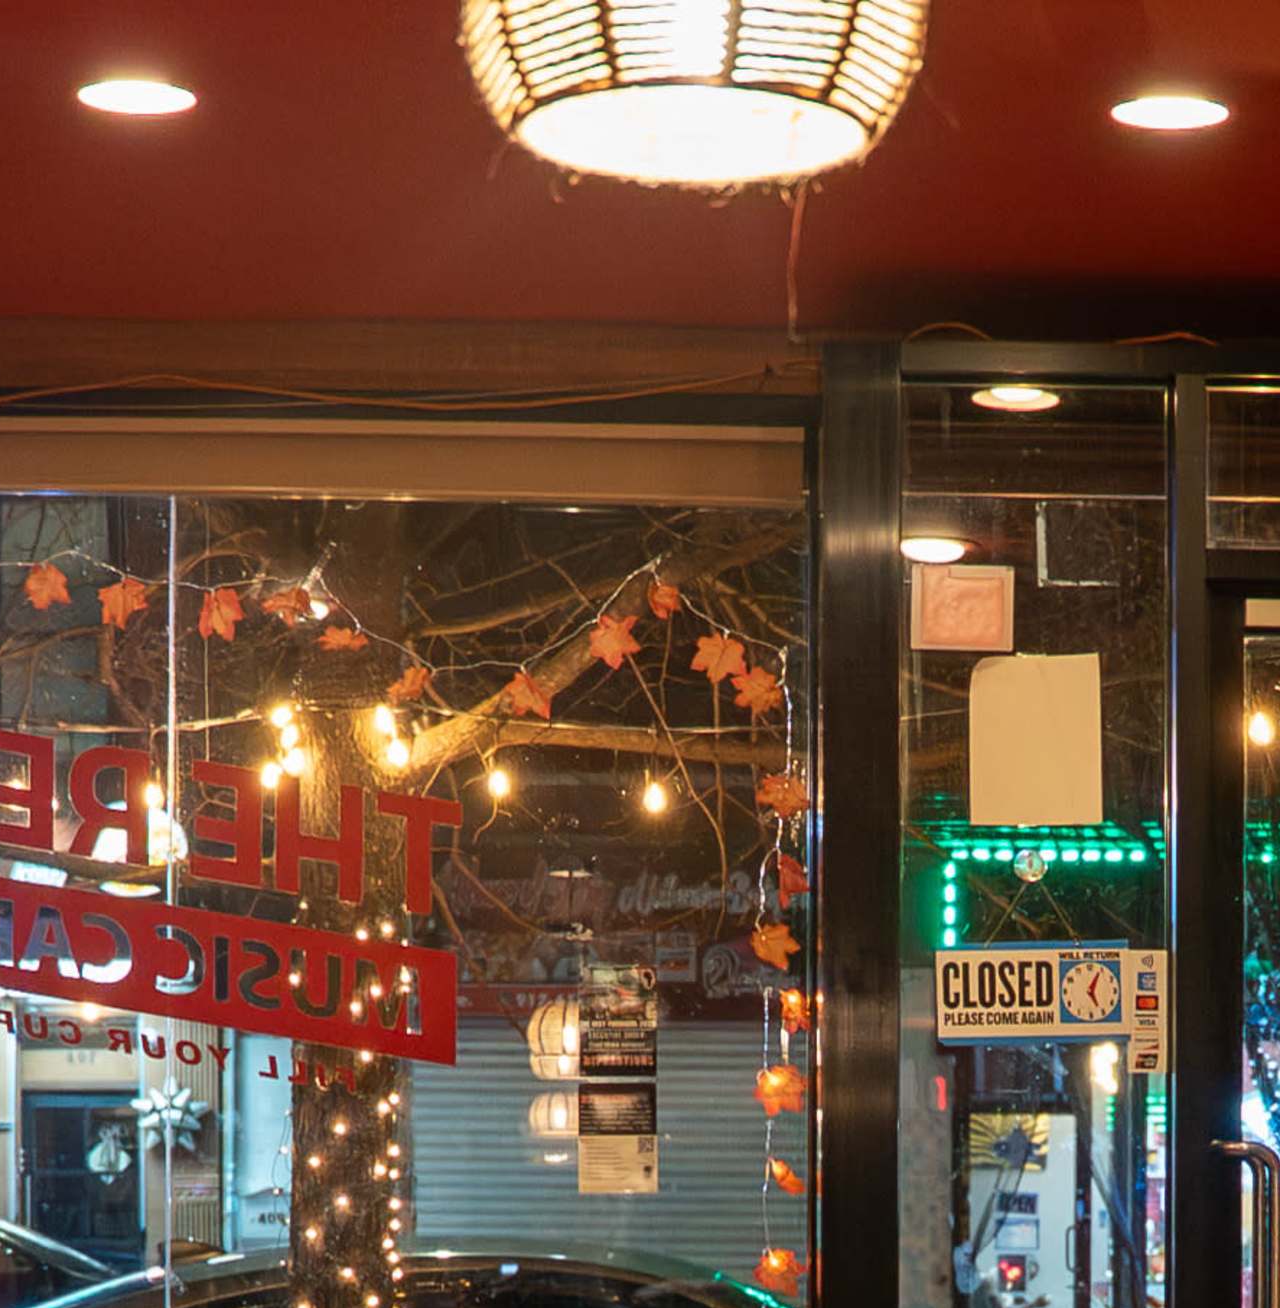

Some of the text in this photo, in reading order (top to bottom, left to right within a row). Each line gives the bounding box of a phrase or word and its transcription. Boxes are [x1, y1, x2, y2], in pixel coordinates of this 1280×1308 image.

[942, 960, 1054, 1010] CLOSED
[944, 1011, 1055, 1027] PLEASE COME AGAIN
